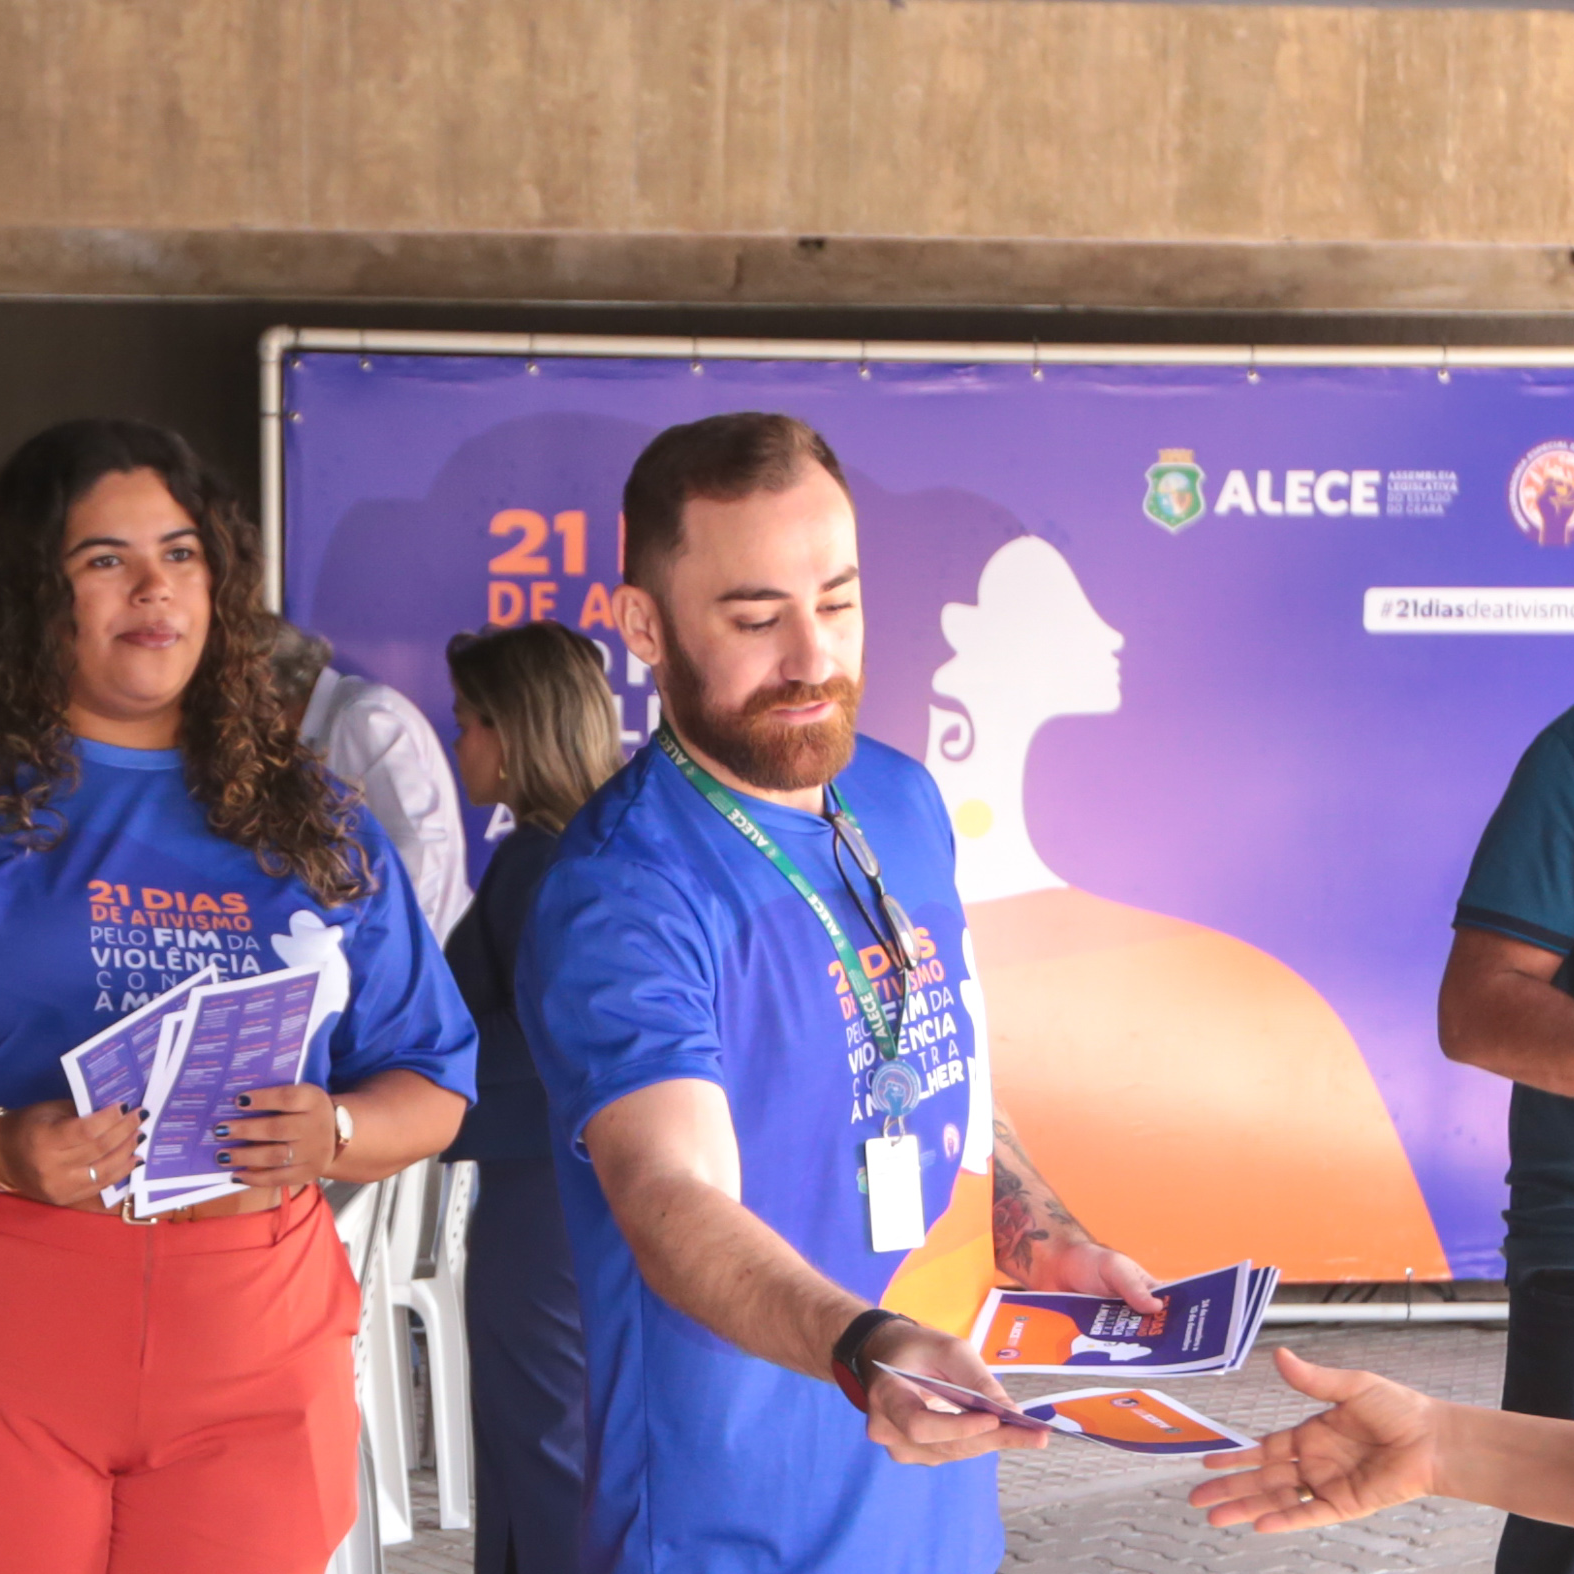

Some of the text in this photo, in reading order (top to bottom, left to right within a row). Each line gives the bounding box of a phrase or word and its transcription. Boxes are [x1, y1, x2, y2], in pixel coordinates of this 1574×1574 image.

[1214, 470, 1380, 515] ALECE
[488, 508, 587, 576] 21
[487, 582, 559, 627] DE
[727, 808, 770, 848] ALECE
[87, 879, 249, 914] 21 DIAS
[91, 904, 253, 932] DE ATIVISMO
[808, 892, 840, 937] ALECE
[90, 926, 261, 951] PELO FIM DA
[91, 946, 261, 975] VIOLÊNCIA
[828, 960, 851, 995] 2
[94, 990, 114, 1012] A
[859, 992, 889, 1038] ALECE
[929, 986, 955, 1013] DA
[848, 1012, 958, 1075] VIOÊNCIA
[851, 1099, 864, 1125] A
